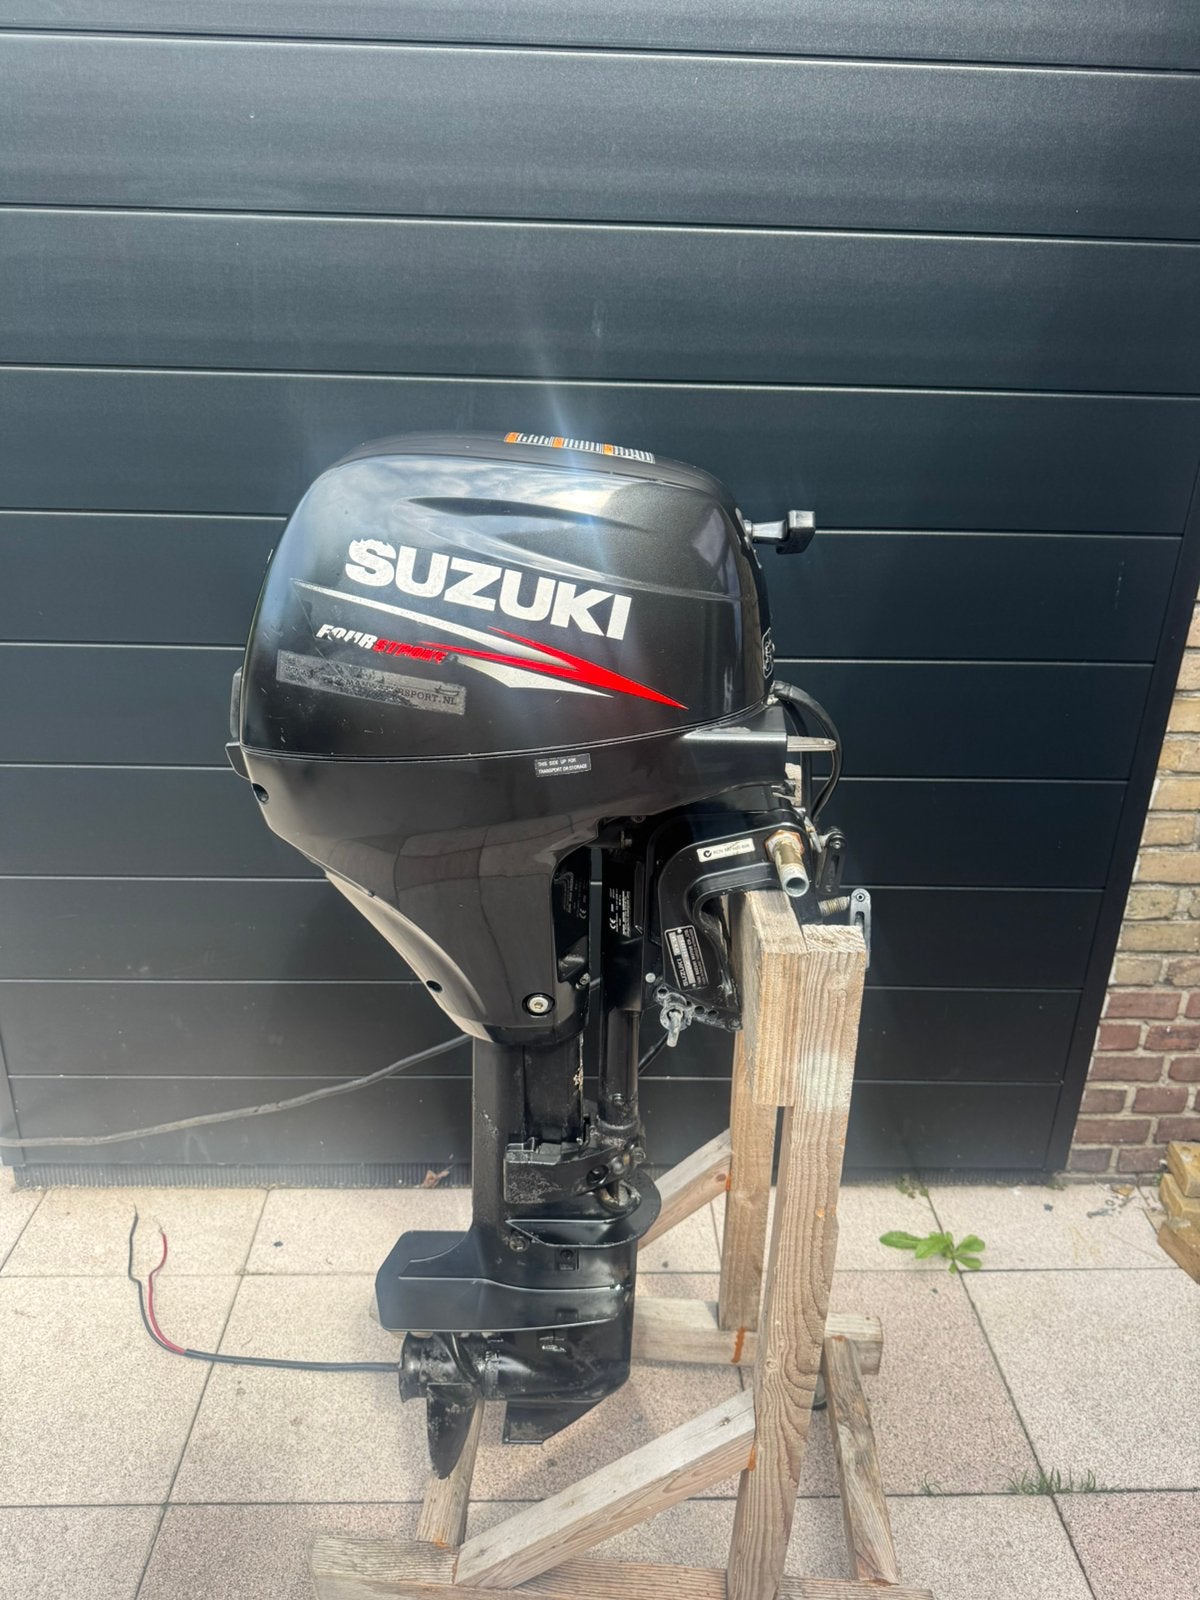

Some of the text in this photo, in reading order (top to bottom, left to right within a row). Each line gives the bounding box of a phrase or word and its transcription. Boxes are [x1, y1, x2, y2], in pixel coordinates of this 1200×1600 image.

[345, 538, 633, 641] SUZUKI
[609, 917, 616, 929] CE
[677, 958, 689, 987] SUZUKI
